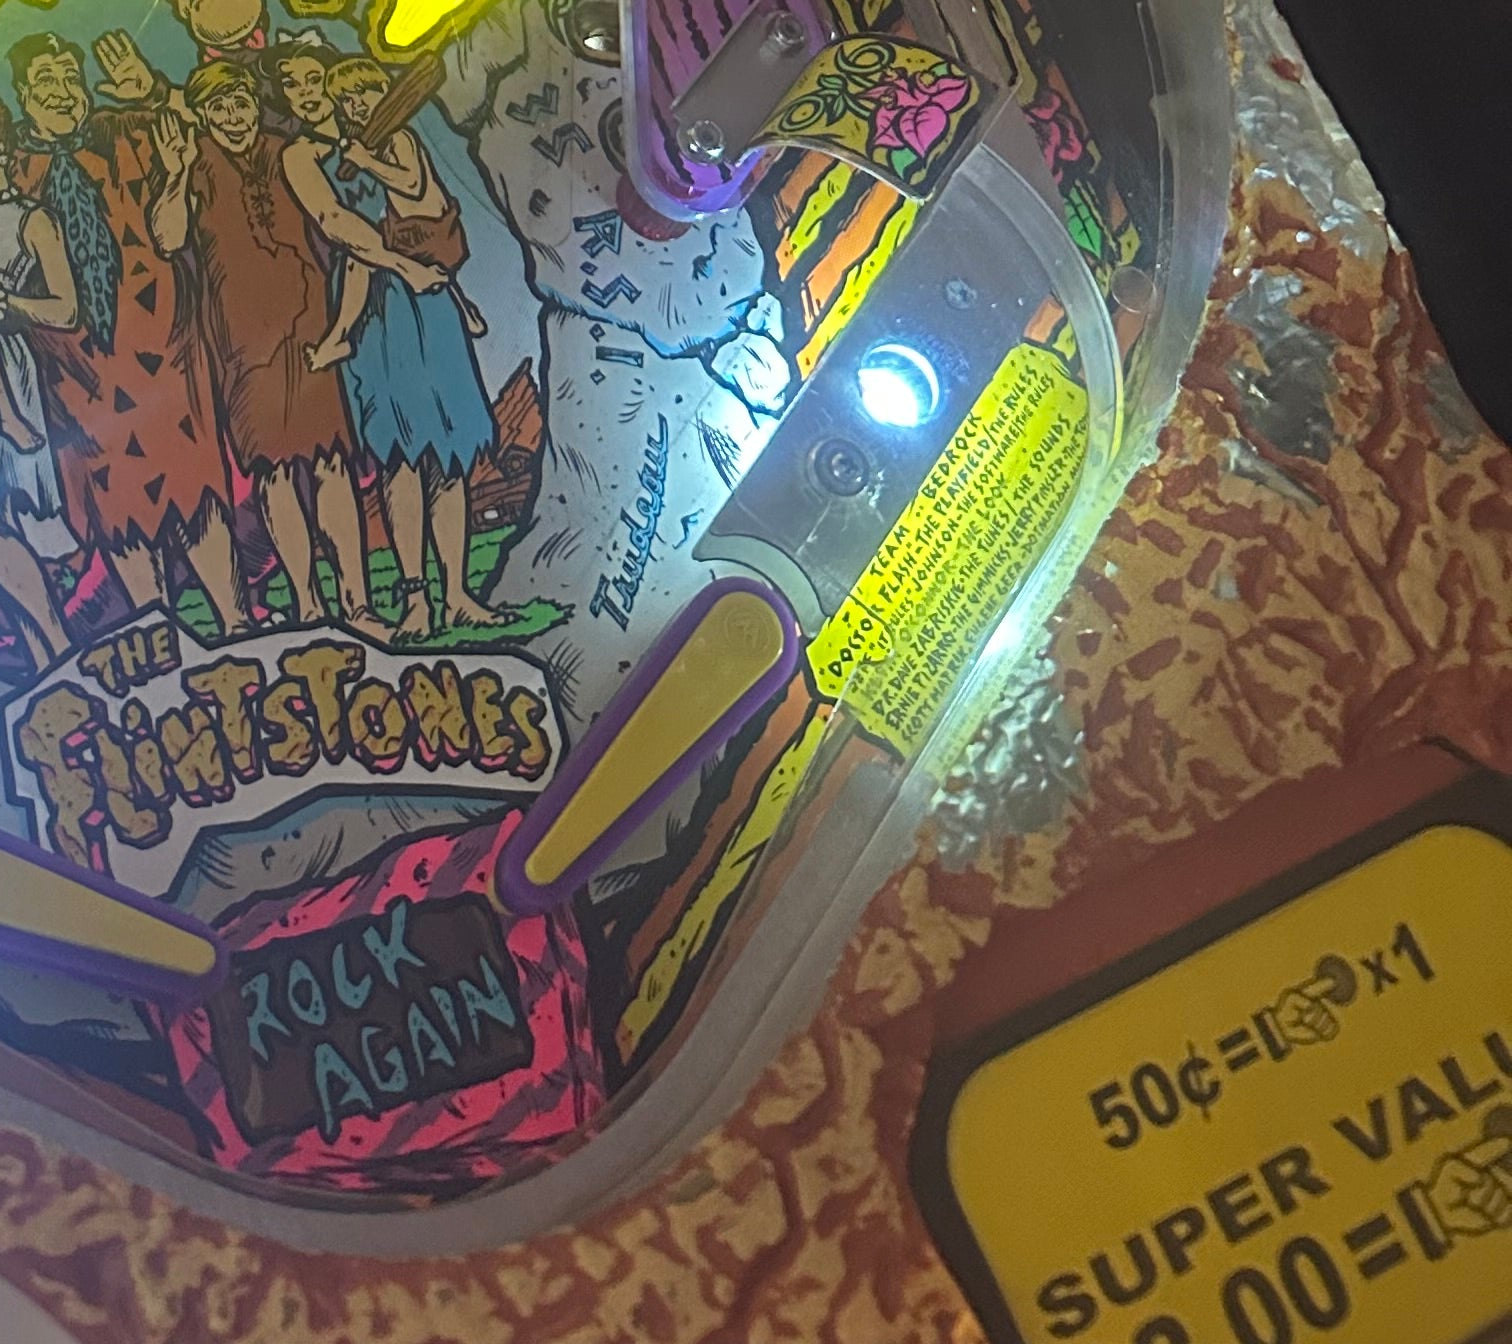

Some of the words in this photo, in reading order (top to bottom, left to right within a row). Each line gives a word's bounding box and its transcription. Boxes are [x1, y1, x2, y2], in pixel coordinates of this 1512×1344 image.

[1001, 363, 1040, 411] RULES
[1026, 372, 1057, 408] RULES
[868, 523, 911, 579] TEAM
[920, 411, 985, 500] BEDROCK
[974, 471, 1014, 520] LOOK
[1009, 473, 1035, 504] THE
[1026, 413, 1073, 473] SOUNDS
[590, 416, 669, 632] Trudeau
[86, 620, 179, 698] THE
[882, 684, 921, 731] ERNIE
[18, 640, 552, 875] FLINTSTONES
[240, 900, 428, 1062] ROCK
[313, 952, 517, 1139] AGAIN
[1033, 1144, 1332, 1339] SUPER
